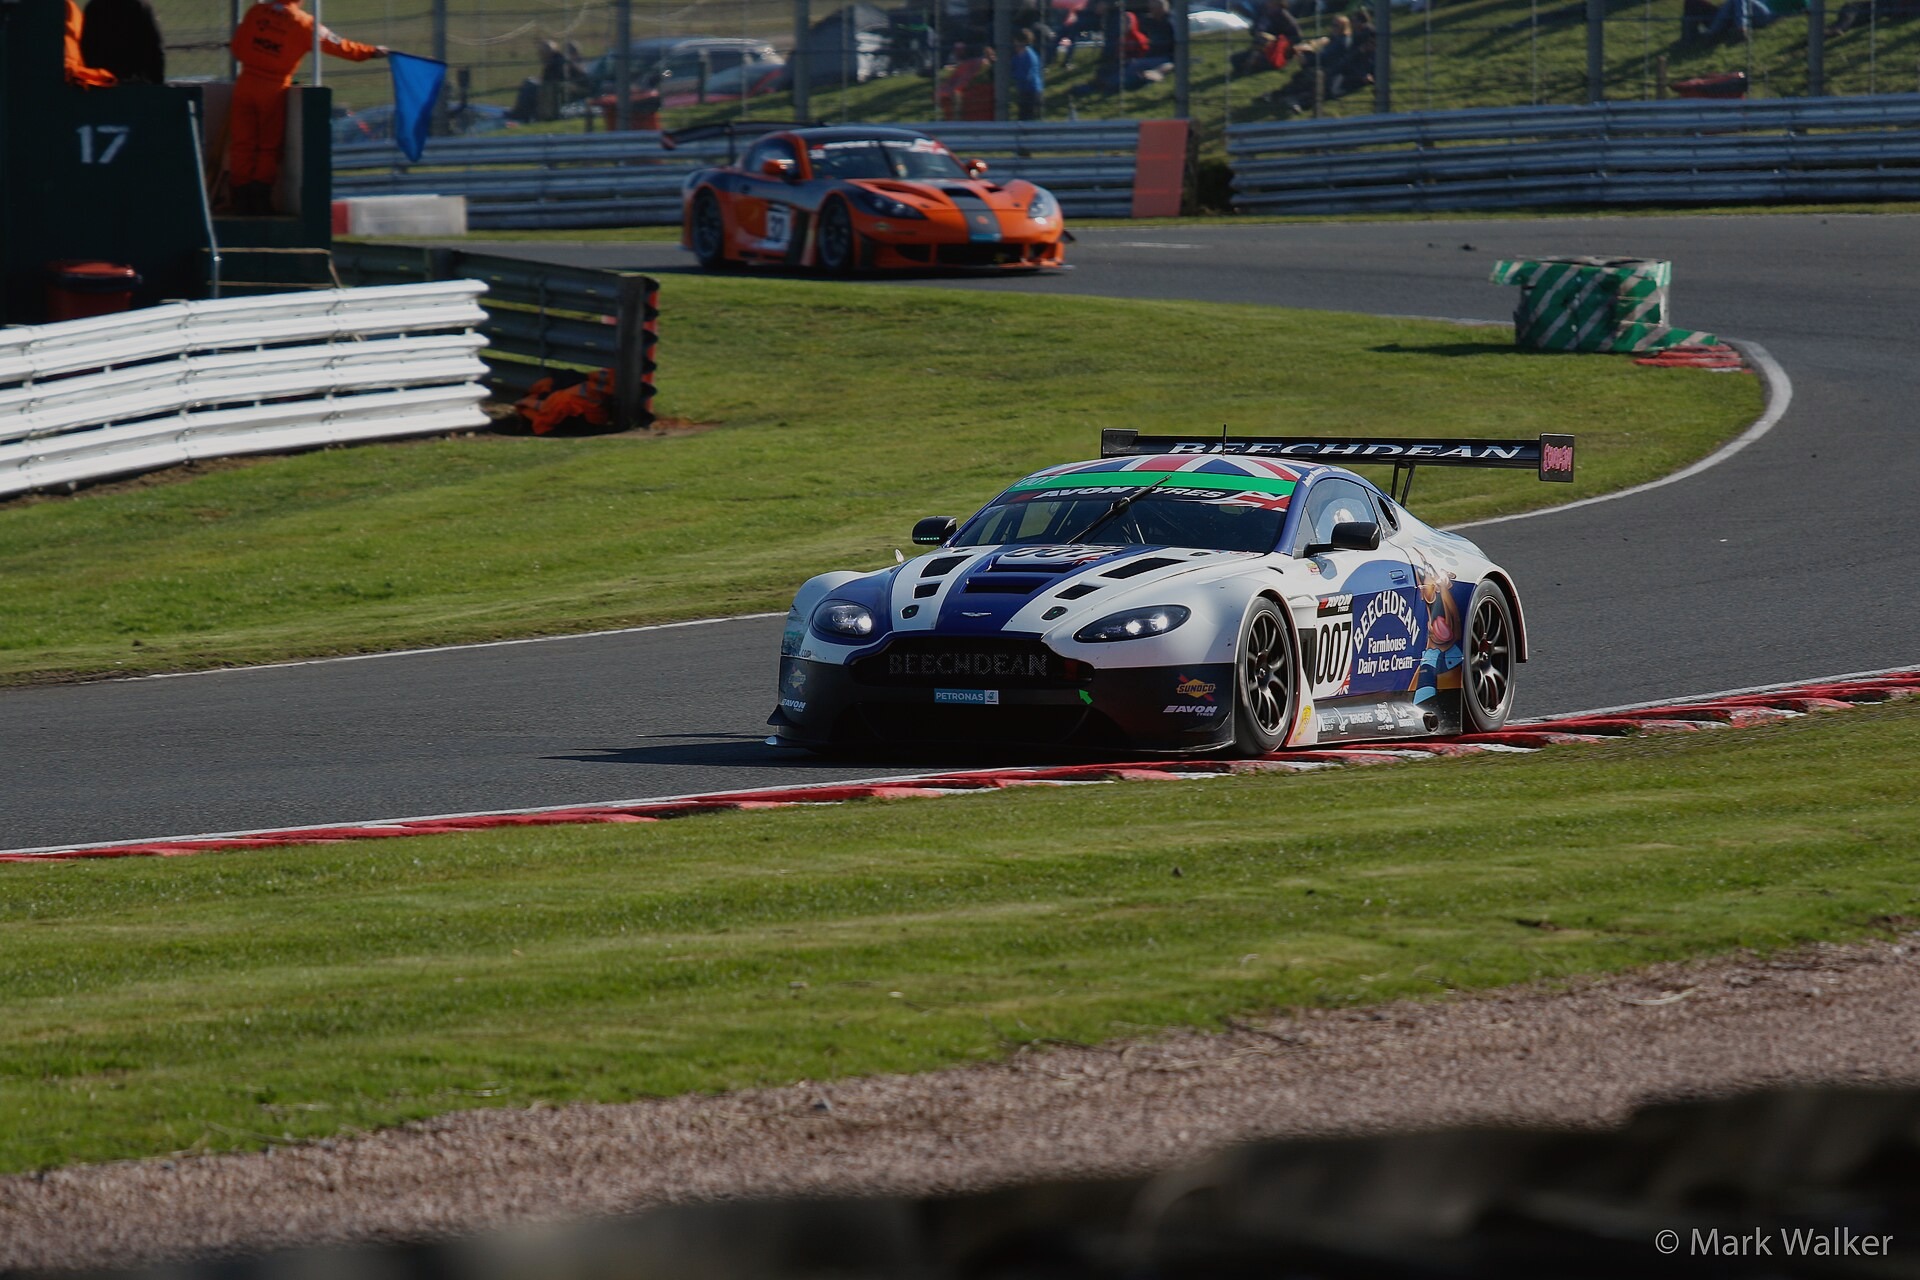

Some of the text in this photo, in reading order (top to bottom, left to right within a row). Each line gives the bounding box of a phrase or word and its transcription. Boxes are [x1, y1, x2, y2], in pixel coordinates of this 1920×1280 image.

[75, 124, 130, 164] 17
[1168, 442, 1525, 459] BEECHDEAN
[1032, 487, 1135, 499] AVON
[1325, 593, 1353, 608] AVON
[1354, 590, 1421, 654] BEECHDEAN
[1316, 621, 1352, 684] 007
[1368, 634, 1407, 654] Farmhouse
[888, 653, 1048, 677] BEECHDEAN
[1357, 654, 1413, 677] Dairy Ice Cream
[935, 692, 984, 701] PETRONAS
[1178, 684, 1214, 693] SUNOCO
[785, 698, 807, 709] AVON
[1175, 705, 1218, 713] AVON
